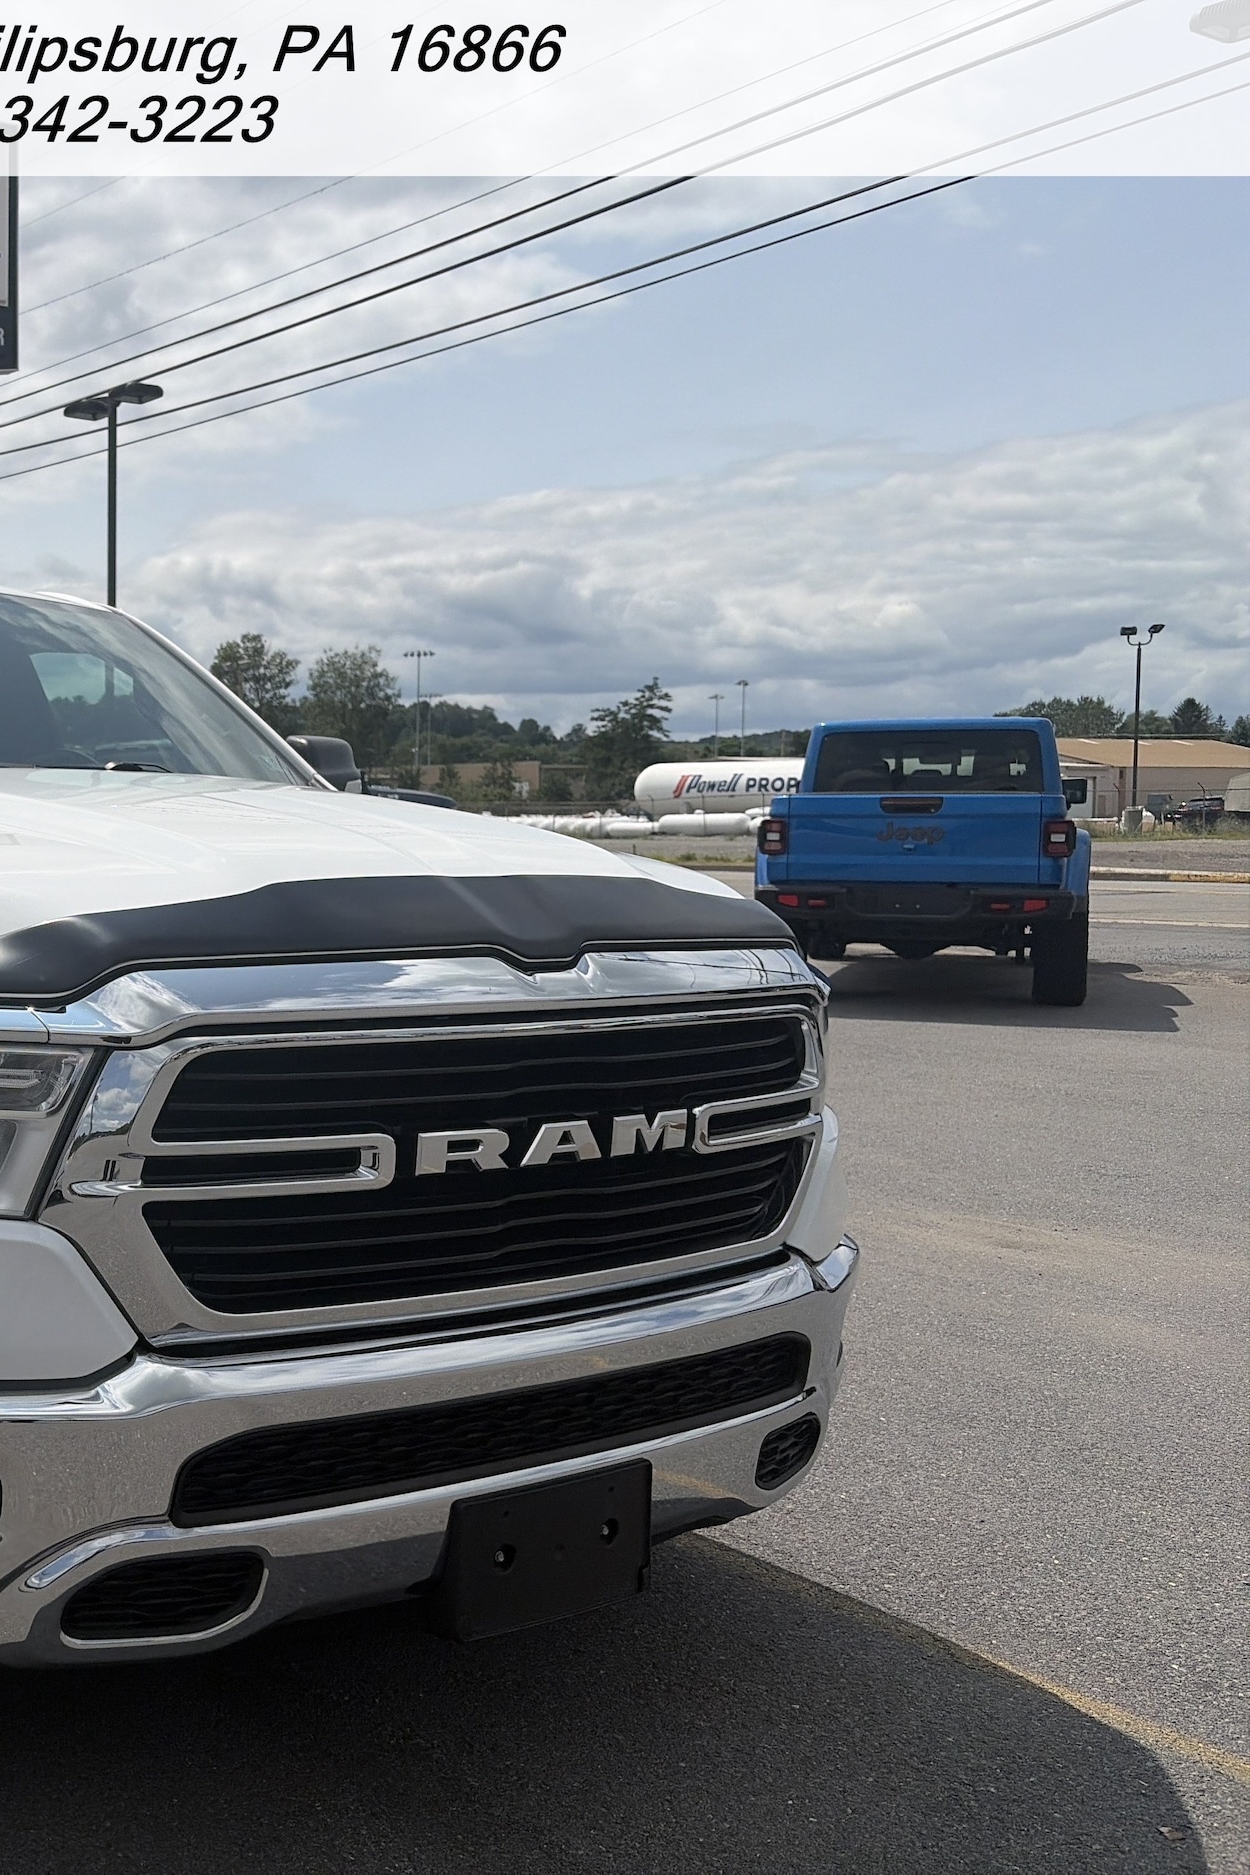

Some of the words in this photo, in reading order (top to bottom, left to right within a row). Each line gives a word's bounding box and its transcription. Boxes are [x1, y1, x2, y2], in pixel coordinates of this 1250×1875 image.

[685, 773, 744, 794] Powell
[876, 821, 945, 846] Jeep
[415, 1108, 688, 1176] RAM
